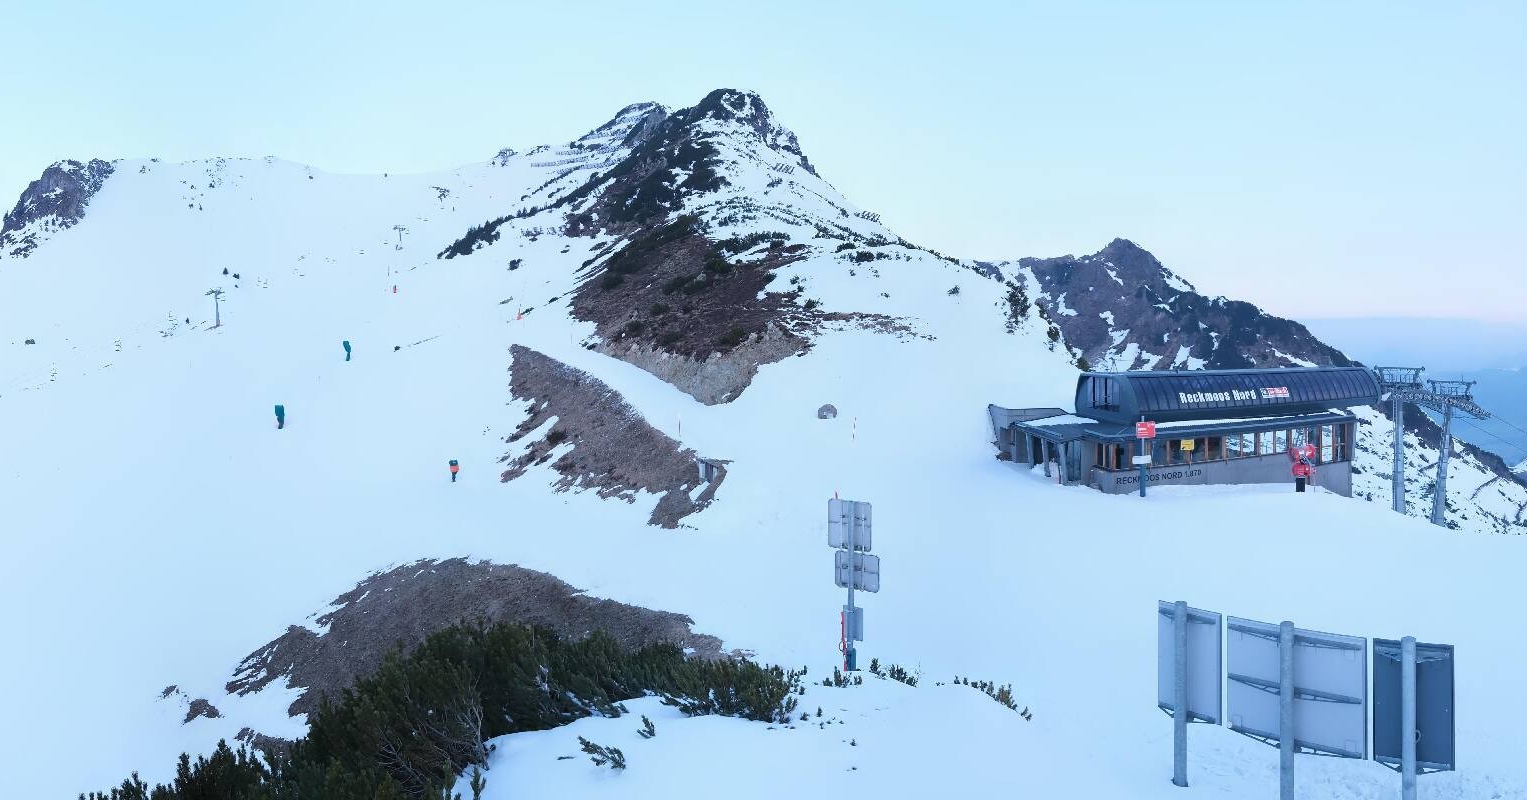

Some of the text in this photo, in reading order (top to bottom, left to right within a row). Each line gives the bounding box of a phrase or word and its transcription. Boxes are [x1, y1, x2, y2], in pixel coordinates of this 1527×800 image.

[1179, 391, 1231, 404] Reckmoos
[1232, 389, 1257, 401] Nord
[1161, 471, 1183, 481] NORD
